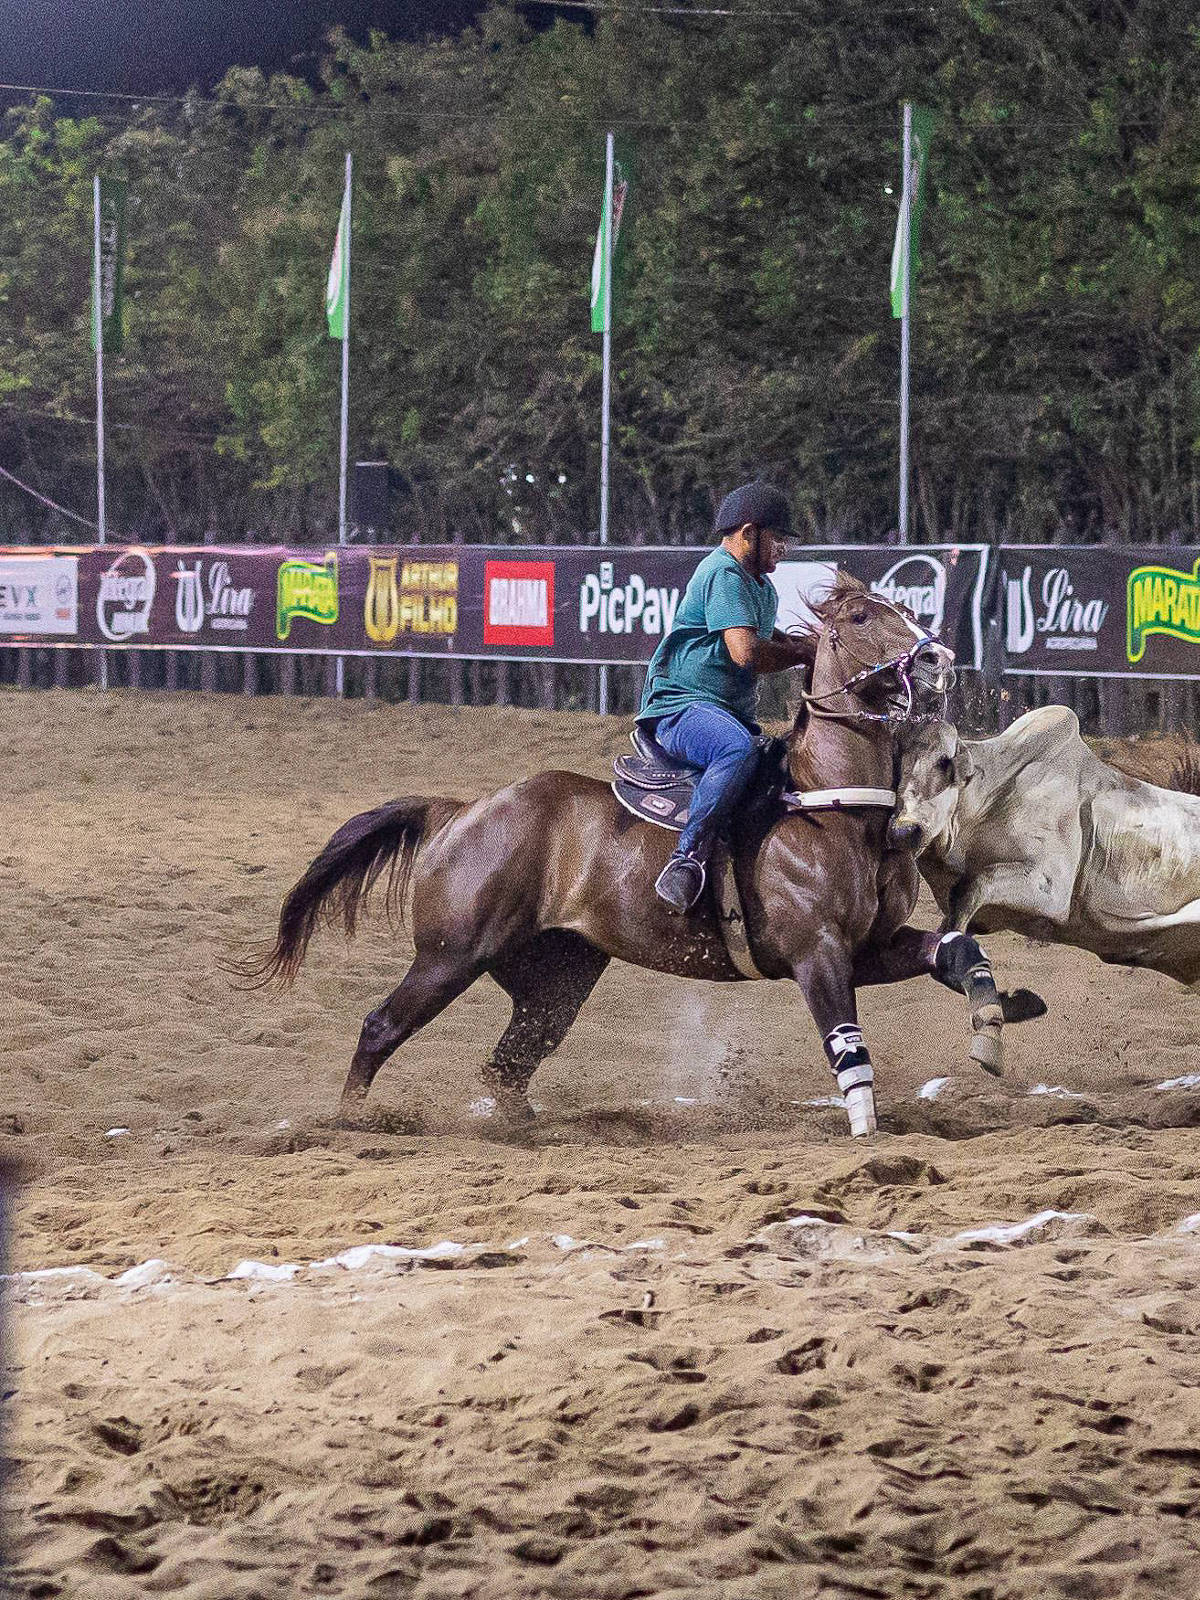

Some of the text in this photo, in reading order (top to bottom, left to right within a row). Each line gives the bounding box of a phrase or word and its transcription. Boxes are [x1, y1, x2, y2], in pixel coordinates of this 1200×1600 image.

[399, 596, 458, 633] FILHO
[580, 562, 679, 637] PicPay
[1036, 568, 1109, 632] Lira
